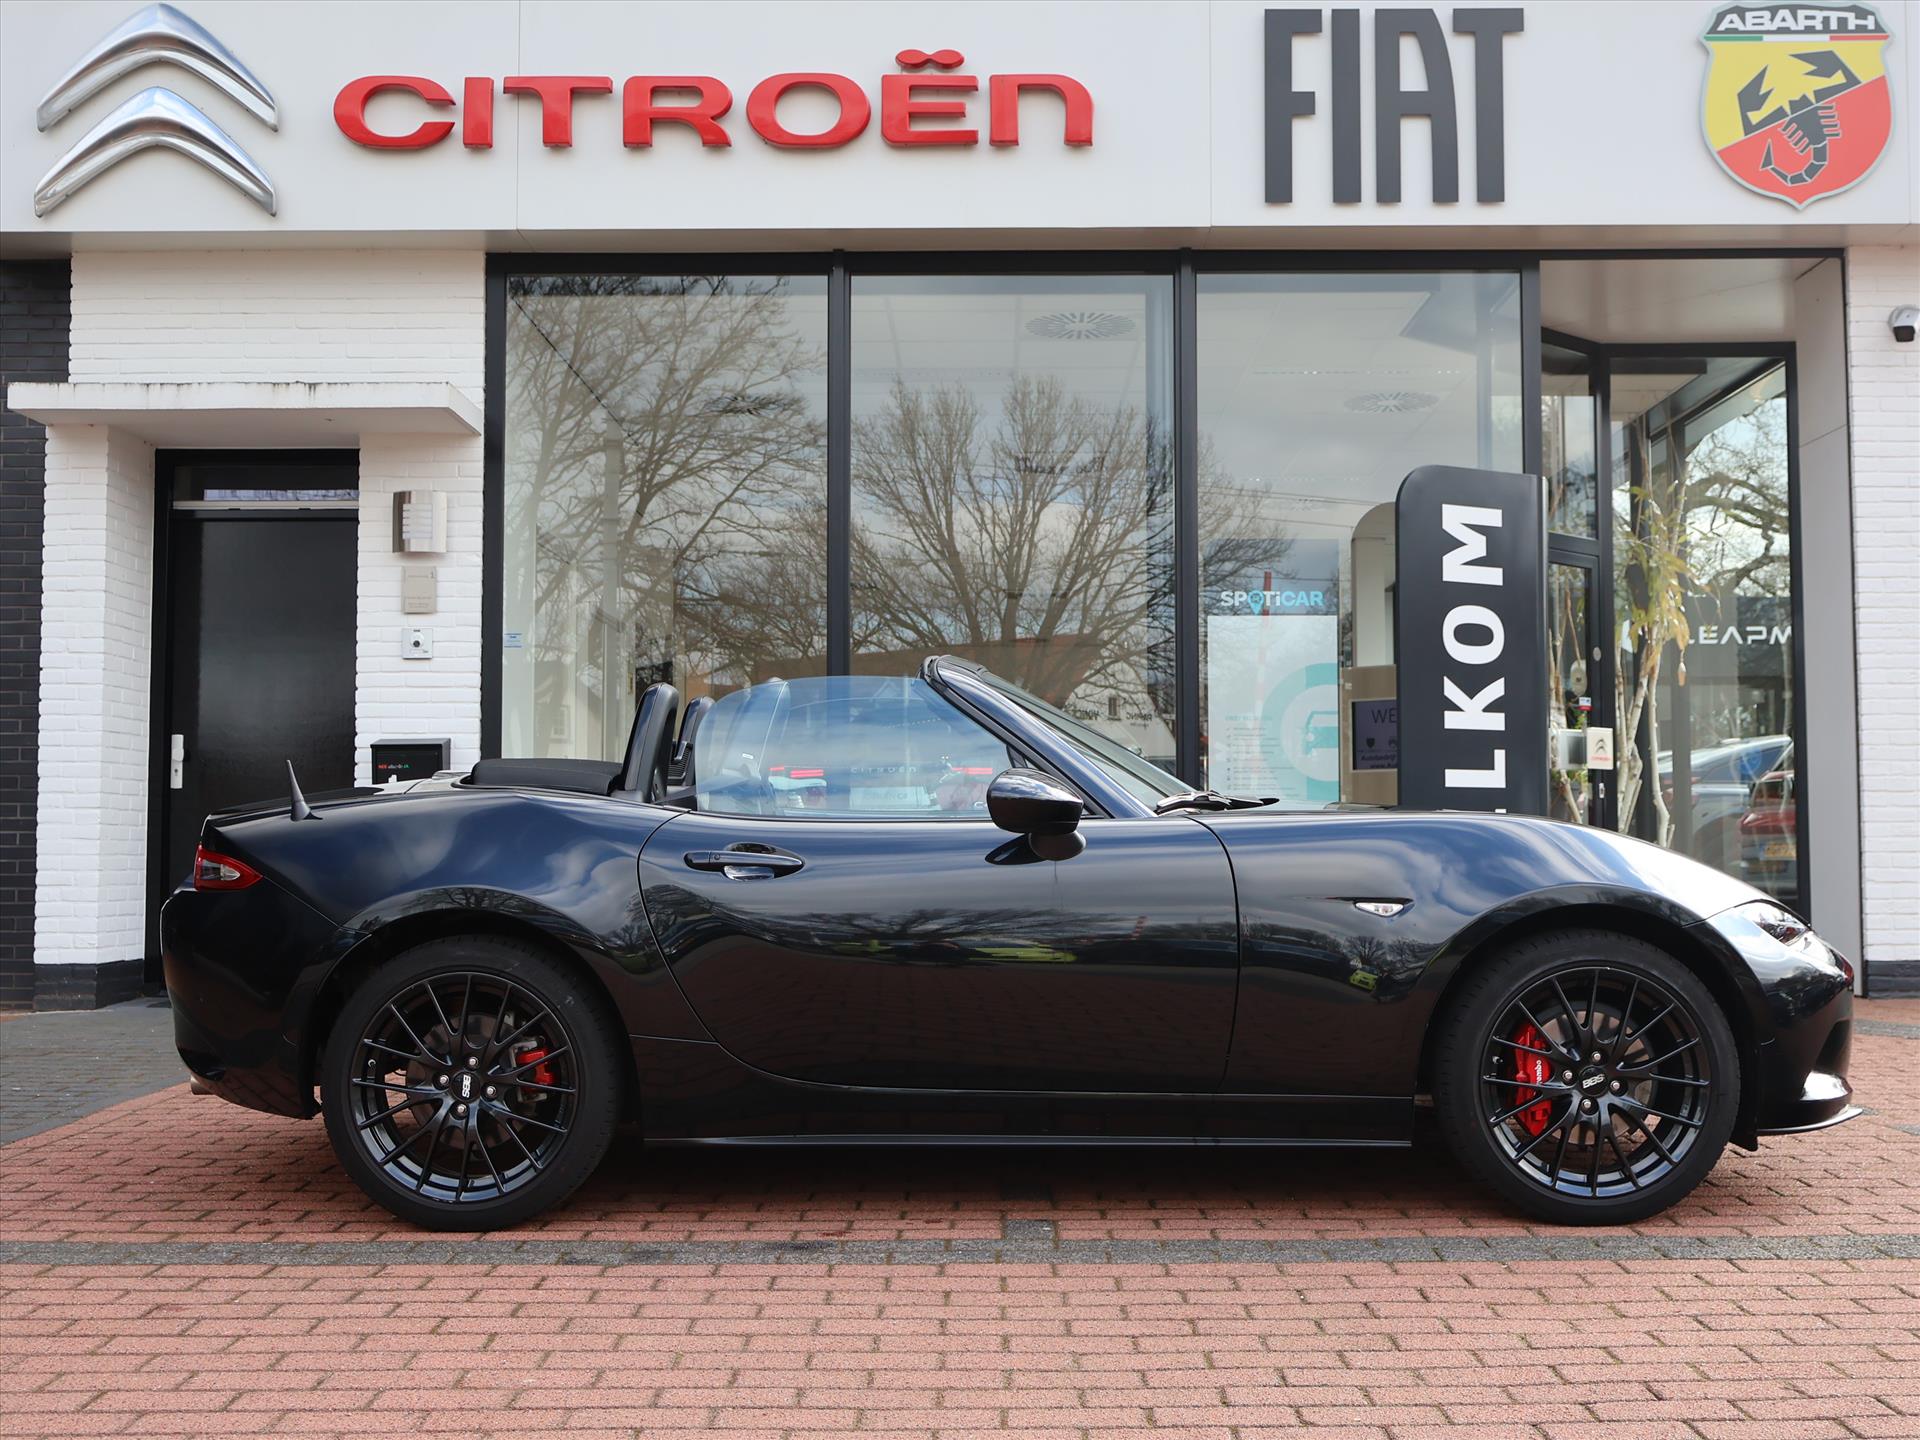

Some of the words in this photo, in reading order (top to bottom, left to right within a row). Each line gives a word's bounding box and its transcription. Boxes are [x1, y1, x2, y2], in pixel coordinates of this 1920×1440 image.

[1716, 9, 1876, 32] ABARTH
[1264, 8, 1524, 204] FIAT
[462, 1075, 471, 1098] BBS
[1582, 1073, 1605, 1088] BBS
